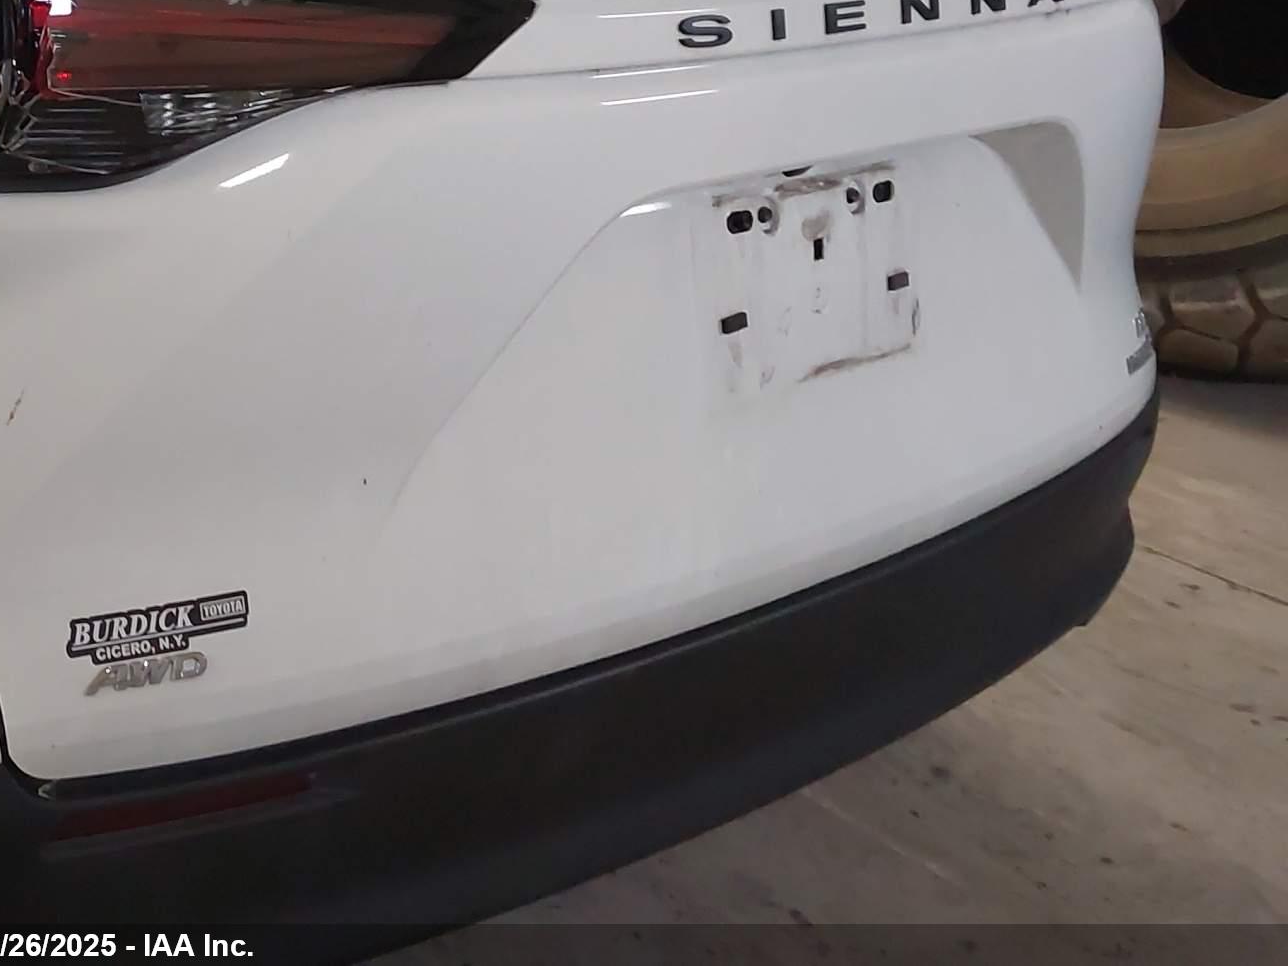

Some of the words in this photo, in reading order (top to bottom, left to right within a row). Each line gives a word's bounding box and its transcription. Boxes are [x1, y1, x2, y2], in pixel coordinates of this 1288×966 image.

[73, 604, 195, 646] BURDICK
[202, 598, 244, 619] TOYOTA
[95, 640, 156, 662] CICERO,
[159, 634, 186, 651] N.Y.
[83, 652, 208, 697] AWD
